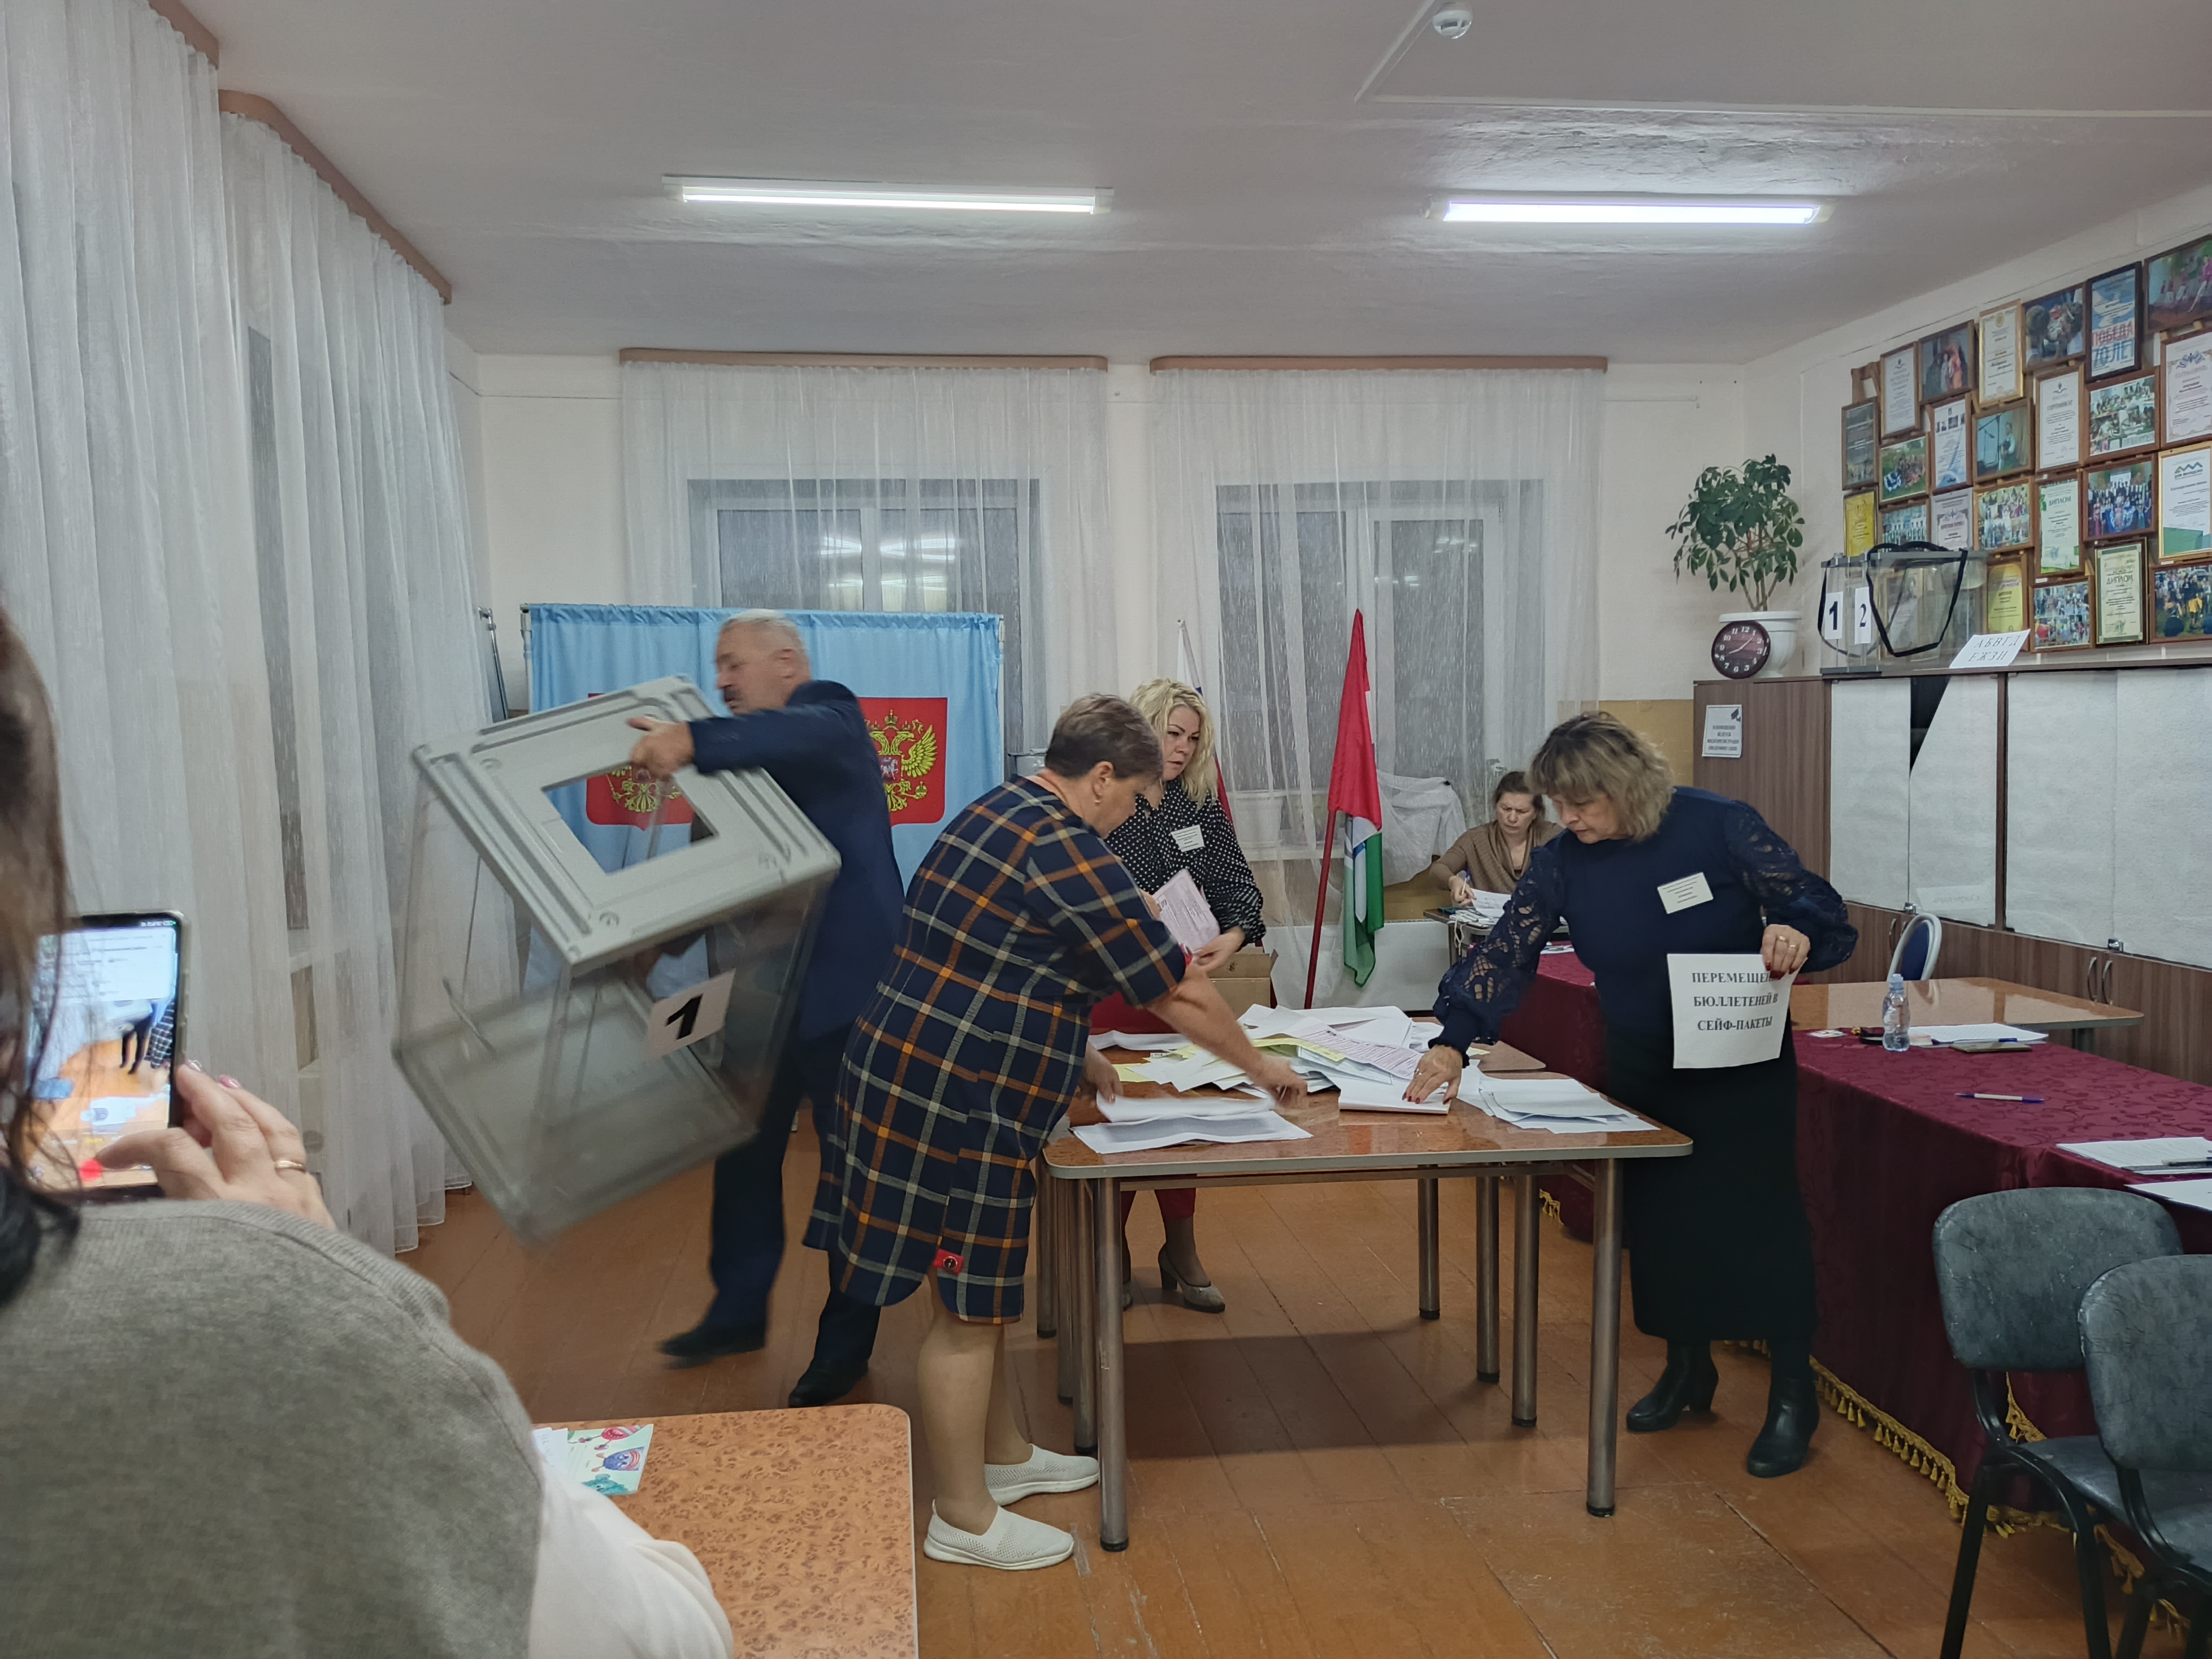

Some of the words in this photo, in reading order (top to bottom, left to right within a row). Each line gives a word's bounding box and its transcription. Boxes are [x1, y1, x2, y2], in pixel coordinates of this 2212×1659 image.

[2048, 496, 2072, 506] ДИПЛОМ
[2106, 574, 2133, 585] ДИПЛОМ
[1829, 601, 1838, 630] 1
[1859, 604, 1867, 628] 2
[1692, 973, 1778, 985] ПЕРЕМЕЩЕН
[1694, 992, 1772, 1007] БЮЛЛЕТЕНЕЙ
[1772, 993, 1779, 1004] В
[665, 993, 704, 1040] 1
[1698, 1016, 1773, 1030] СЕЙФ-ПАКЕТЫ
